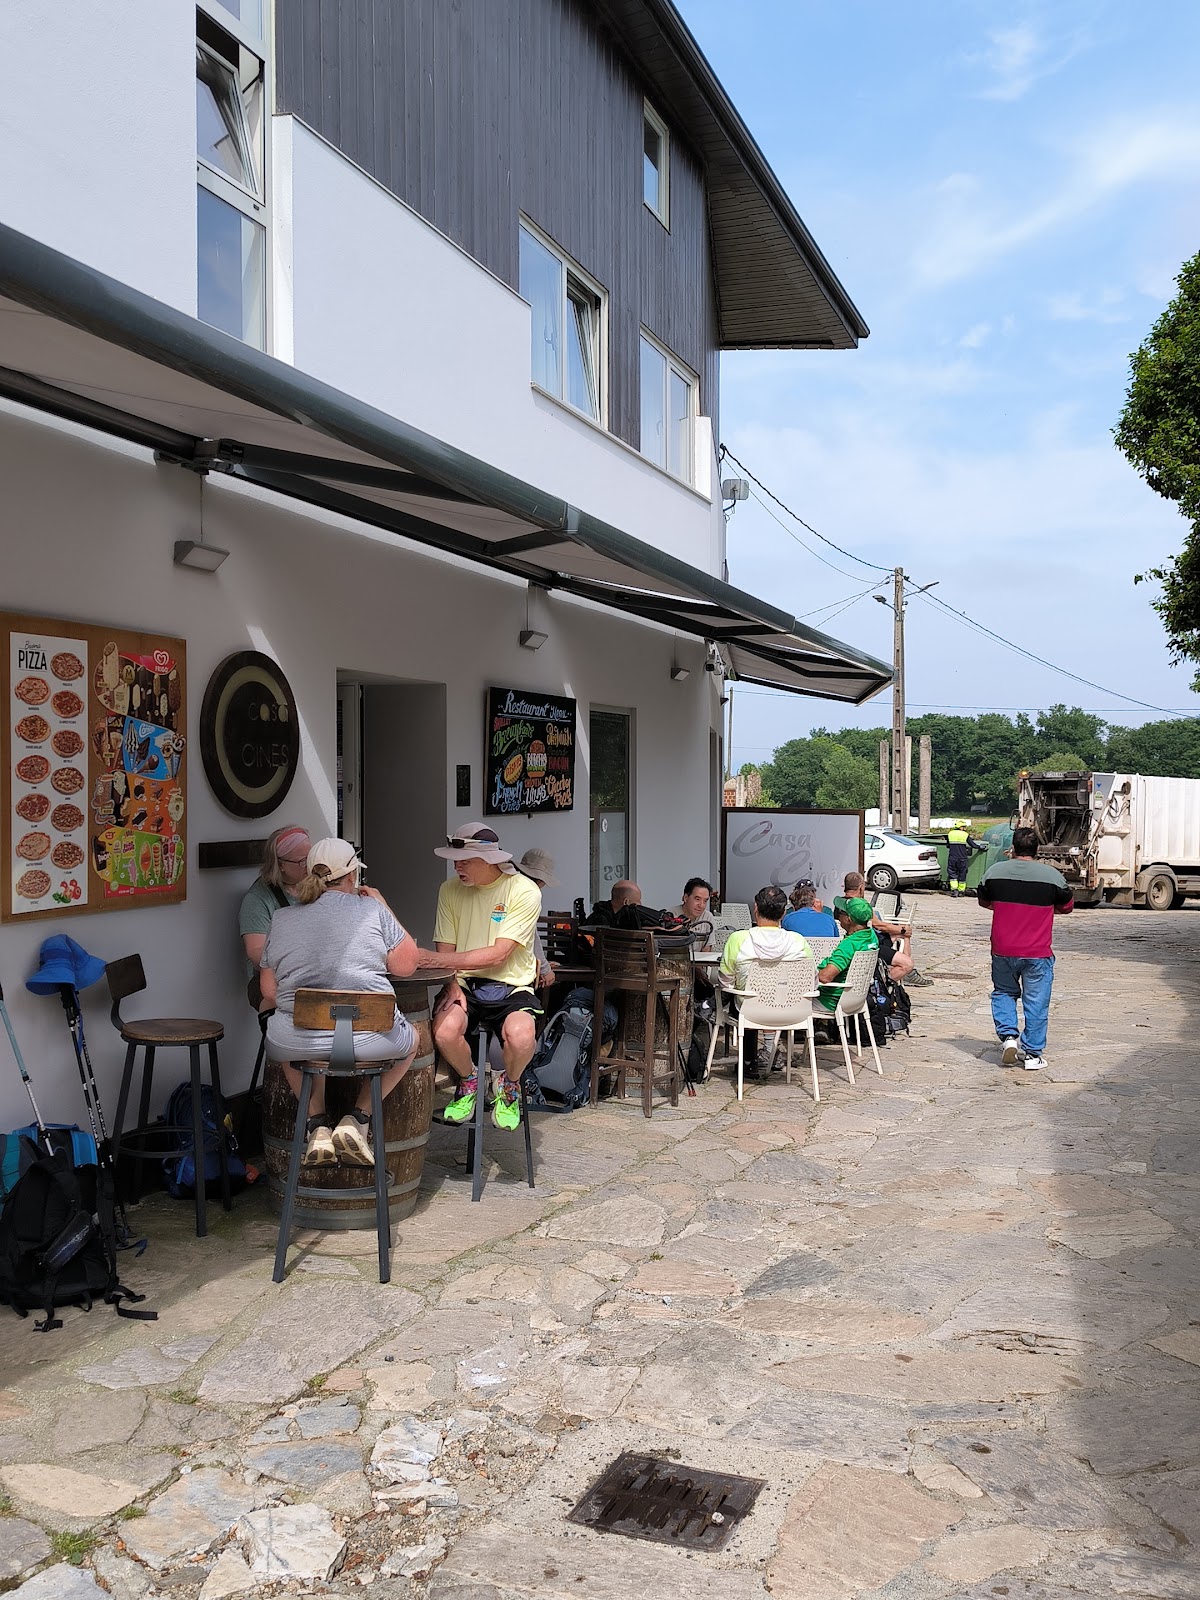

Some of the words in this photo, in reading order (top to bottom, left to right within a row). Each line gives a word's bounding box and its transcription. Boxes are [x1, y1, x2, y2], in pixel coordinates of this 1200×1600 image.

[18, 650, 47, 670] PIZZA
[155, 665, 169, 673] FRIGO
[503, 690, 550, 717] Restaurant
[549, 705, 568, 722] Menu
[241, 743, 289, 768] CINES
[732, 820, 812, 857] Casa
